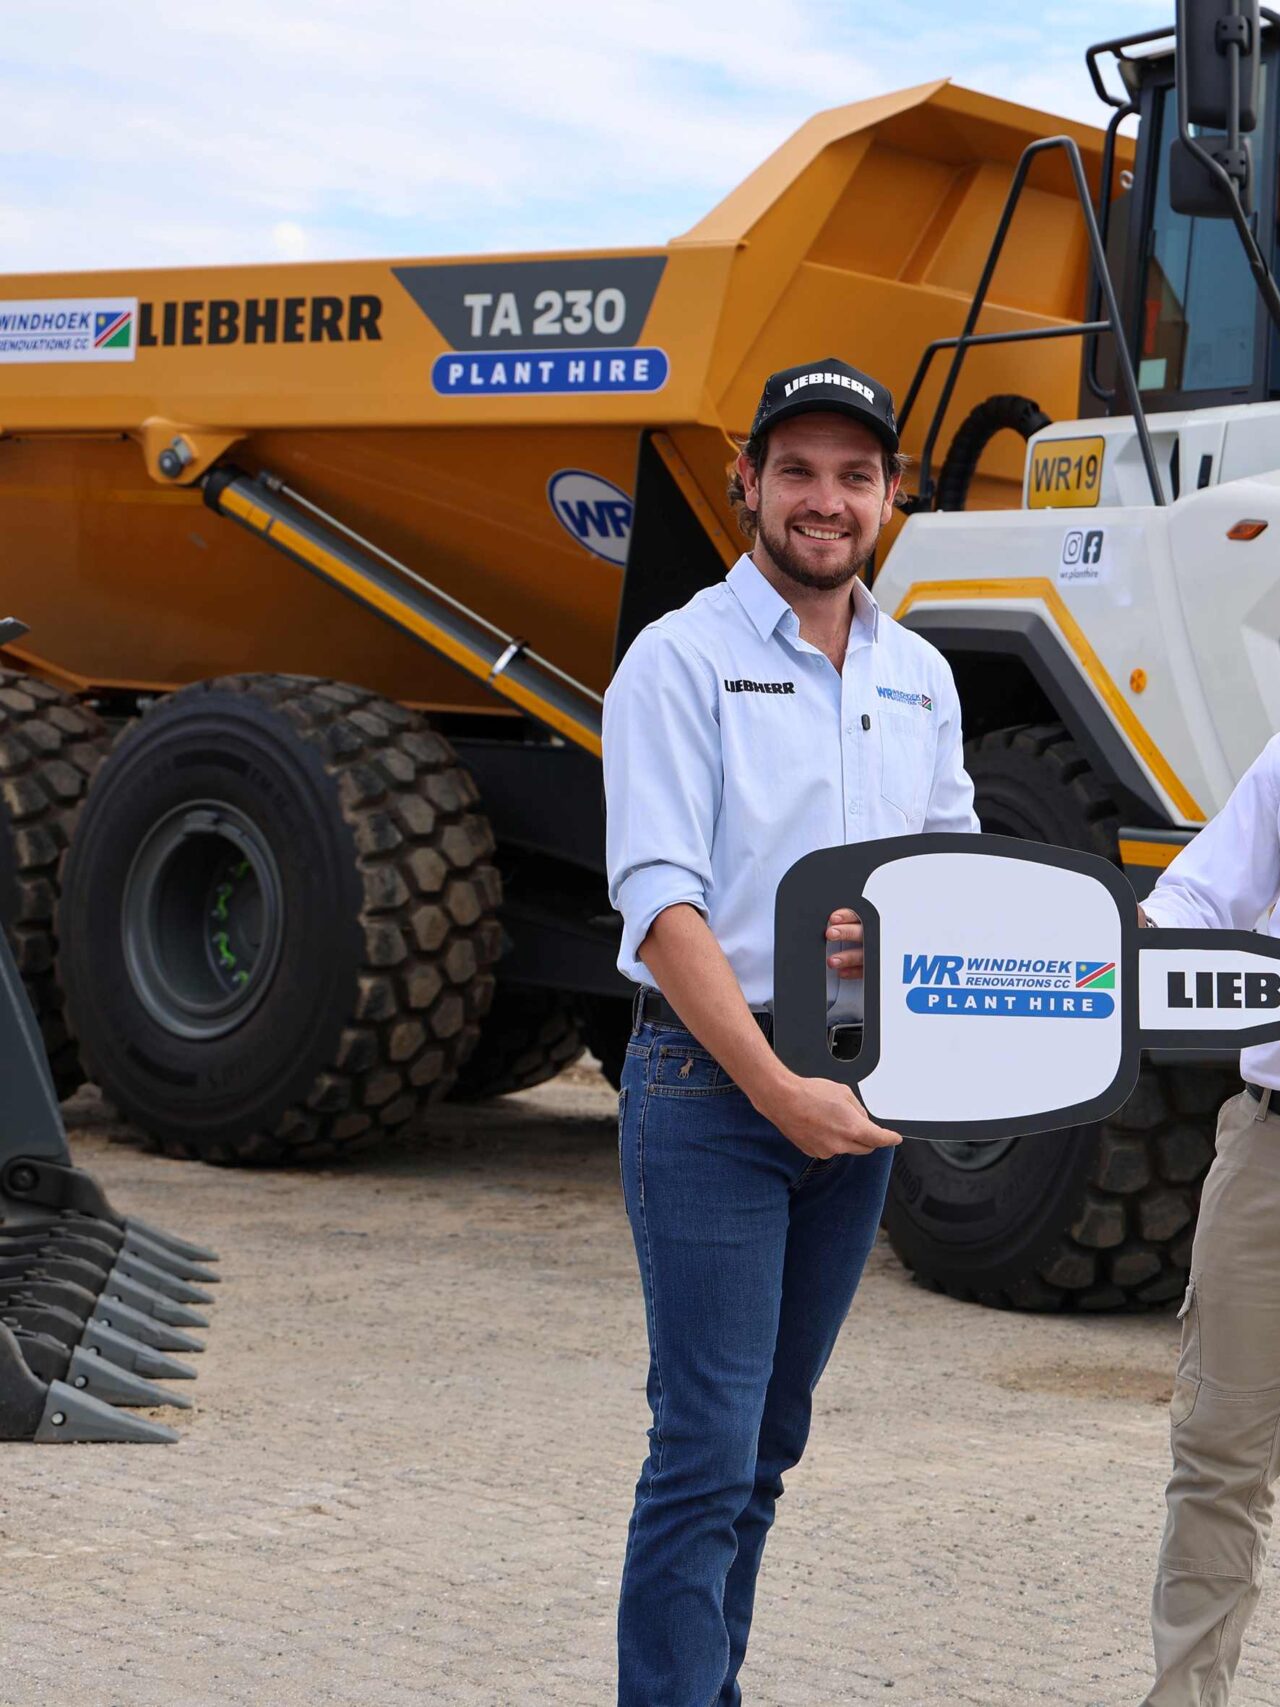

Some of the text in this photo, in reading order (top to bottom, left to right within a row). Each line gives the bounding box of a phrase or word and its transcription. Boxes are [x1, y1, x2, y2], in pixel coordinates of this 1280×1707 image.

[0, 311, 91, 331] WINDHOEK
[139, 294, 383, 347] LIEBHERR
[464, 288, 626, 337] TA 230
[448, 358, 650, 386] PLANT HIRE
[784, 372, 875, 405] LIEBHERR
[1034, 453, 1098, 492] WR19
[559, 500, 634, 537] WR
[724, 679, 796, 694] LIEBHERR
[876, 685, 894, 700] WR
[902, 954, 1072, 985] WR WINDHOEK
[965, 977, 1071, 989] RENOVATIONS CC
[928, 994, 1094, 1012] PLANT HIRE
